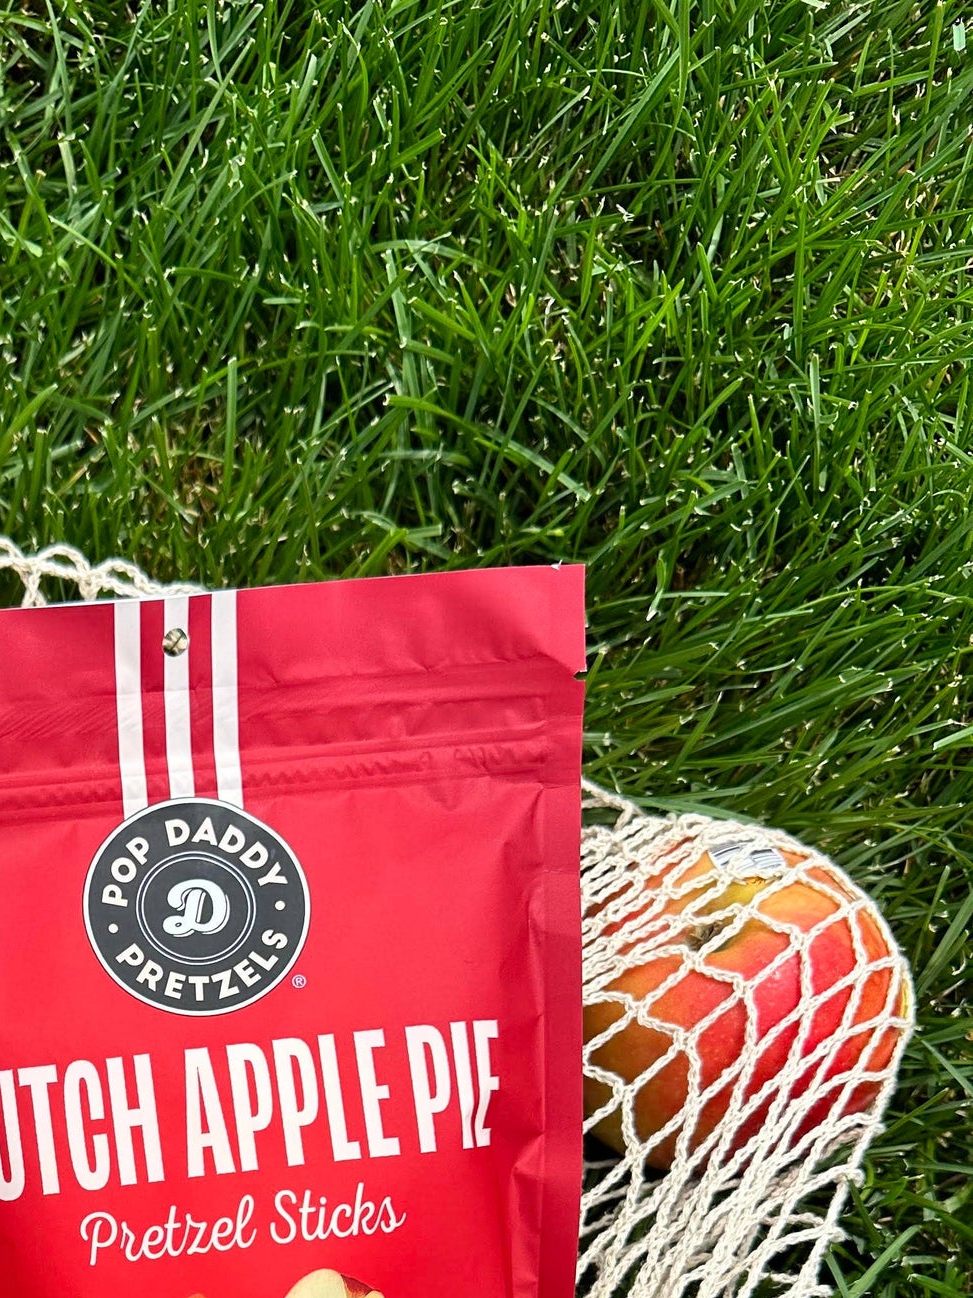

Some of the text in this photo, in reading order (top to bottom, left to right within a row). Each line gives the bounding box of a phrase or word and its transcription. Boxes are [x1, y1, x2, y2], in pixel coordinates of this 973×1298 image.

[101, 816, 288, 908] POP DADDY
[115, 928, 289, 1002] PRETZELS
[184, 1028, 401, 1178] APPLE
[405, 1019, 500, 1154] PIE
[80, 1182, 407, 1266] Pretzel Sticks
